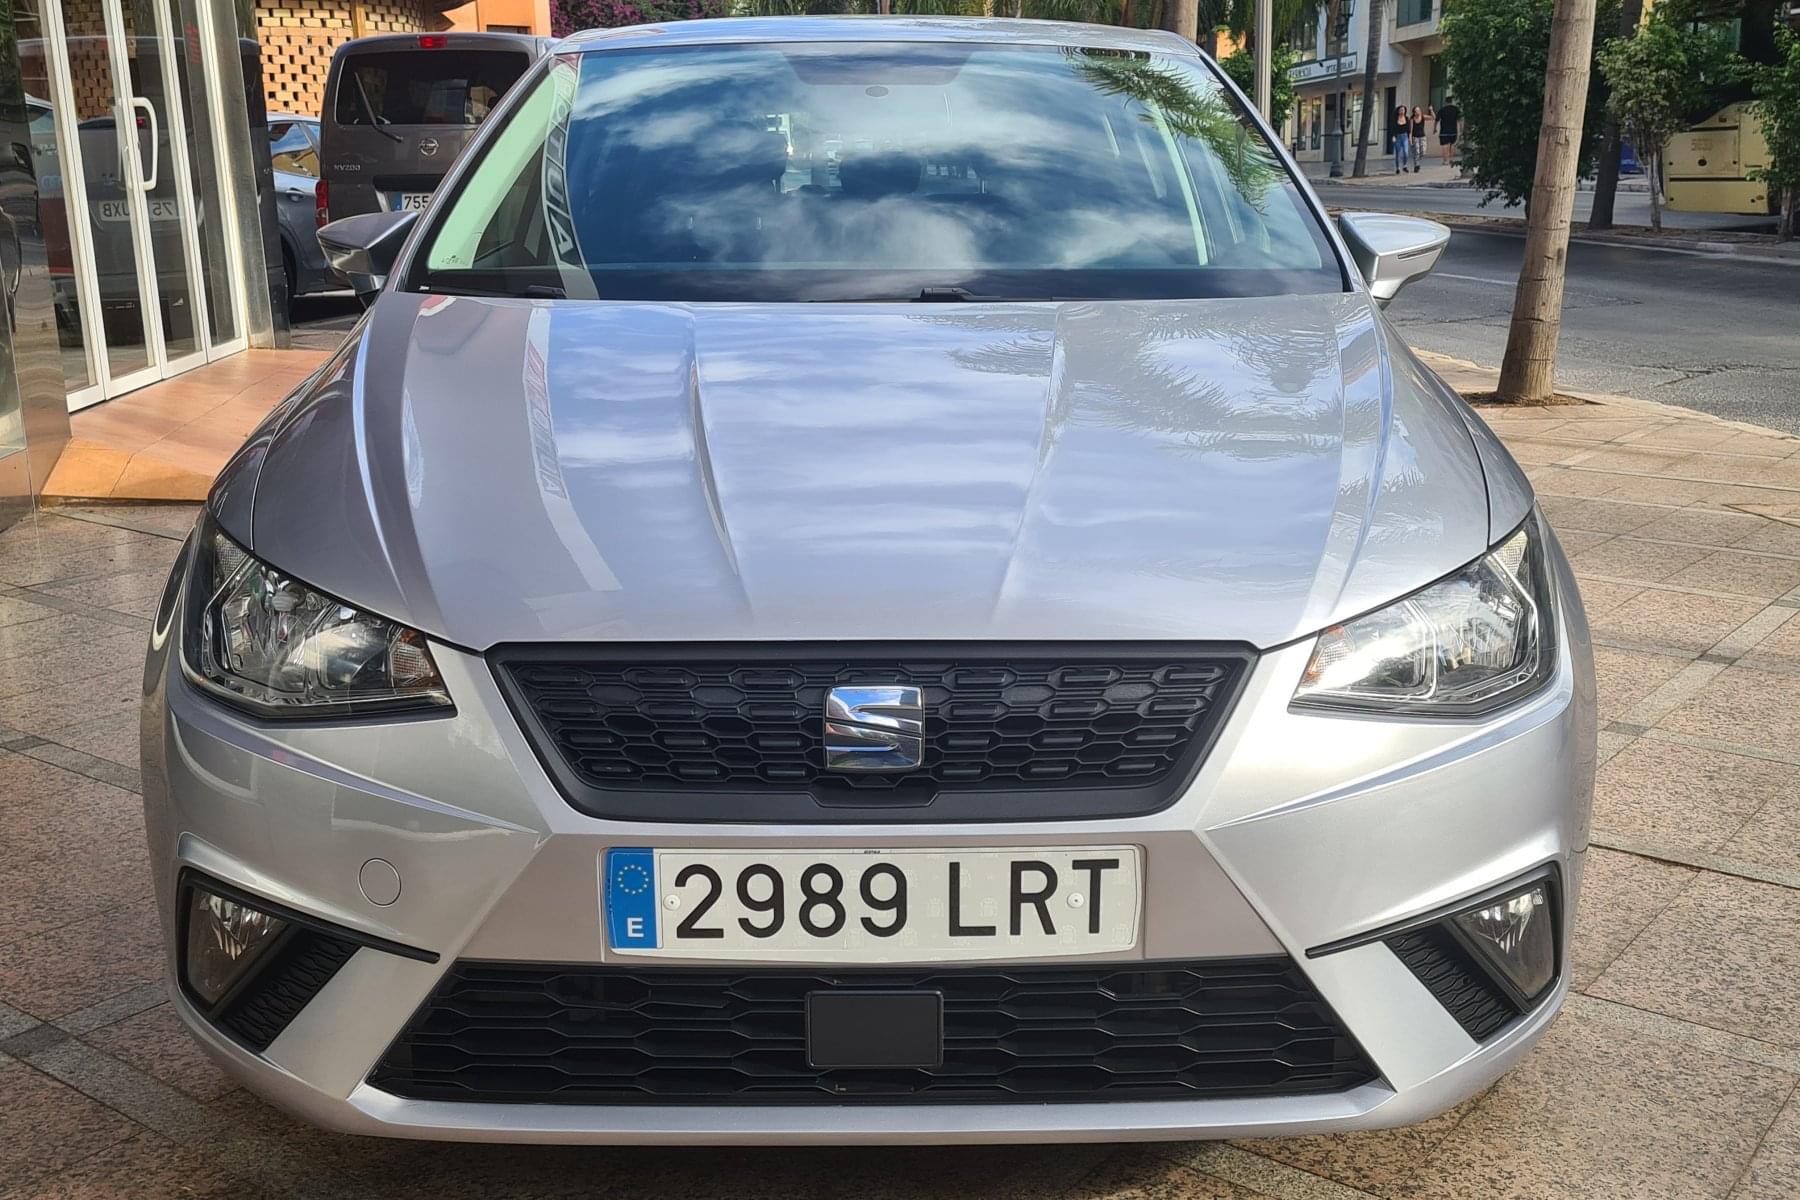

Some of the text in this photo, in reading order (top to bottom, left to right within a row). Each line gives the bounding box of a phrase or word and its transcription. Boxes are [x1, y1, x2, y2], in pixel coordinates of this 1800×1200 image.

[404, 195, 430, 210] 755
[674, 858, 1120, 939] 2989 LRT
[626, 917, 645, 938] E
